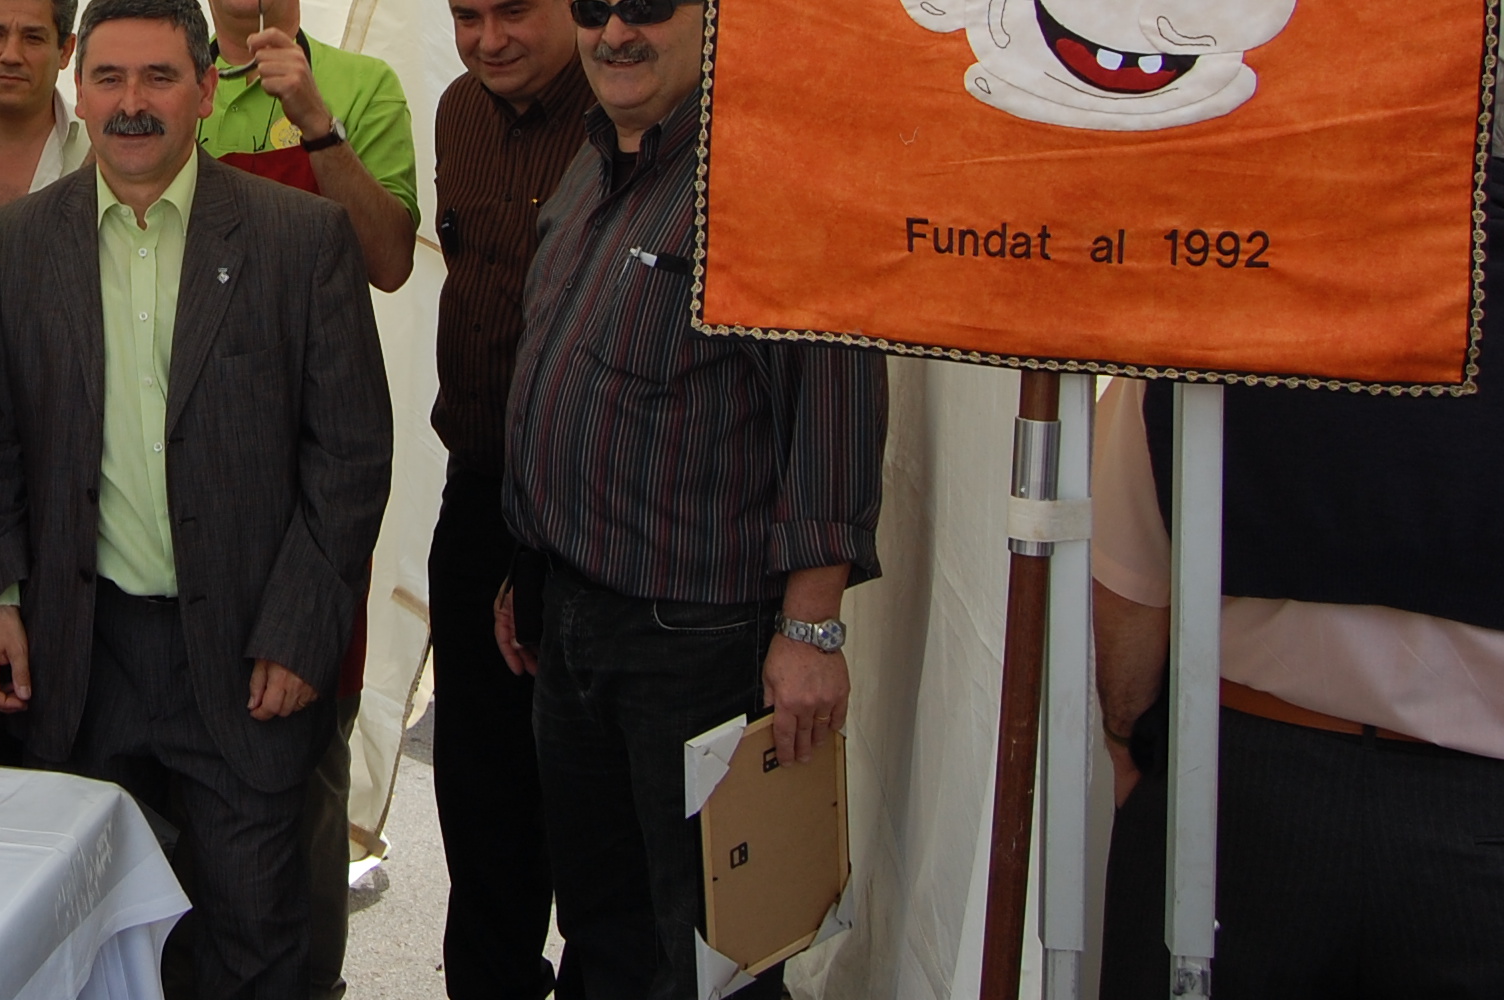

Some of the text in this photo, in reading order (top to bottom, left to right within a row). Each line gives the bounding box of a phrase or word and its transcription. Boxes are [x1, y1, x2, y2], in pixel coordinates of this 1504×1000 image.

[905, 217, 1271, 269] Fundat al 1992
